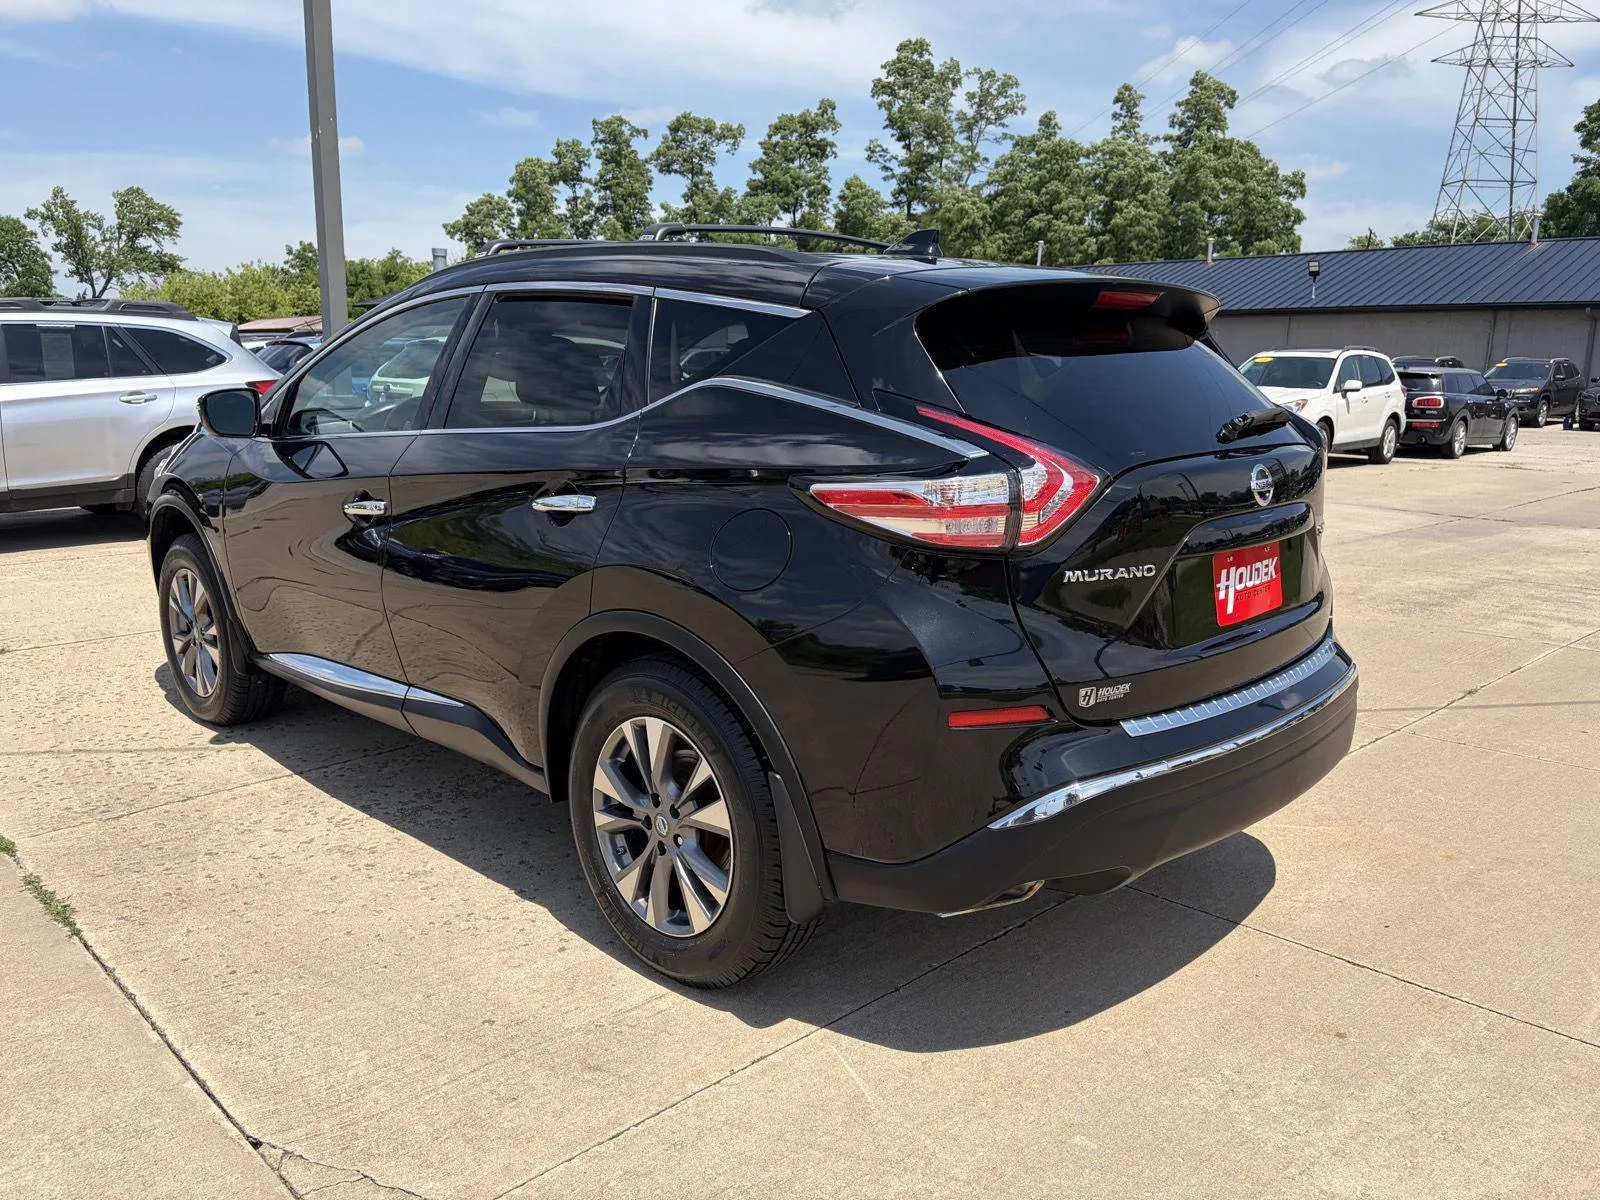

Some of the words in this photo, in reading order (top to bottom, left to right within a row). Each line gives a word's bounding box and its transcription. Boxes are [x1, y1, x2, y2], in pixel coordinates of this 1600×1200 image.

[1063, 564, 1156, 583] MURANO
[1216, 557, 1278, 614] HOUDEK
[1236, 591, 1252, 602] AUTO
[1253, 585, 1271, 597] CENTER
[1097, 683, 1131, 697] HOUDEK
[650, 691, 719, 755] MICHELIN
